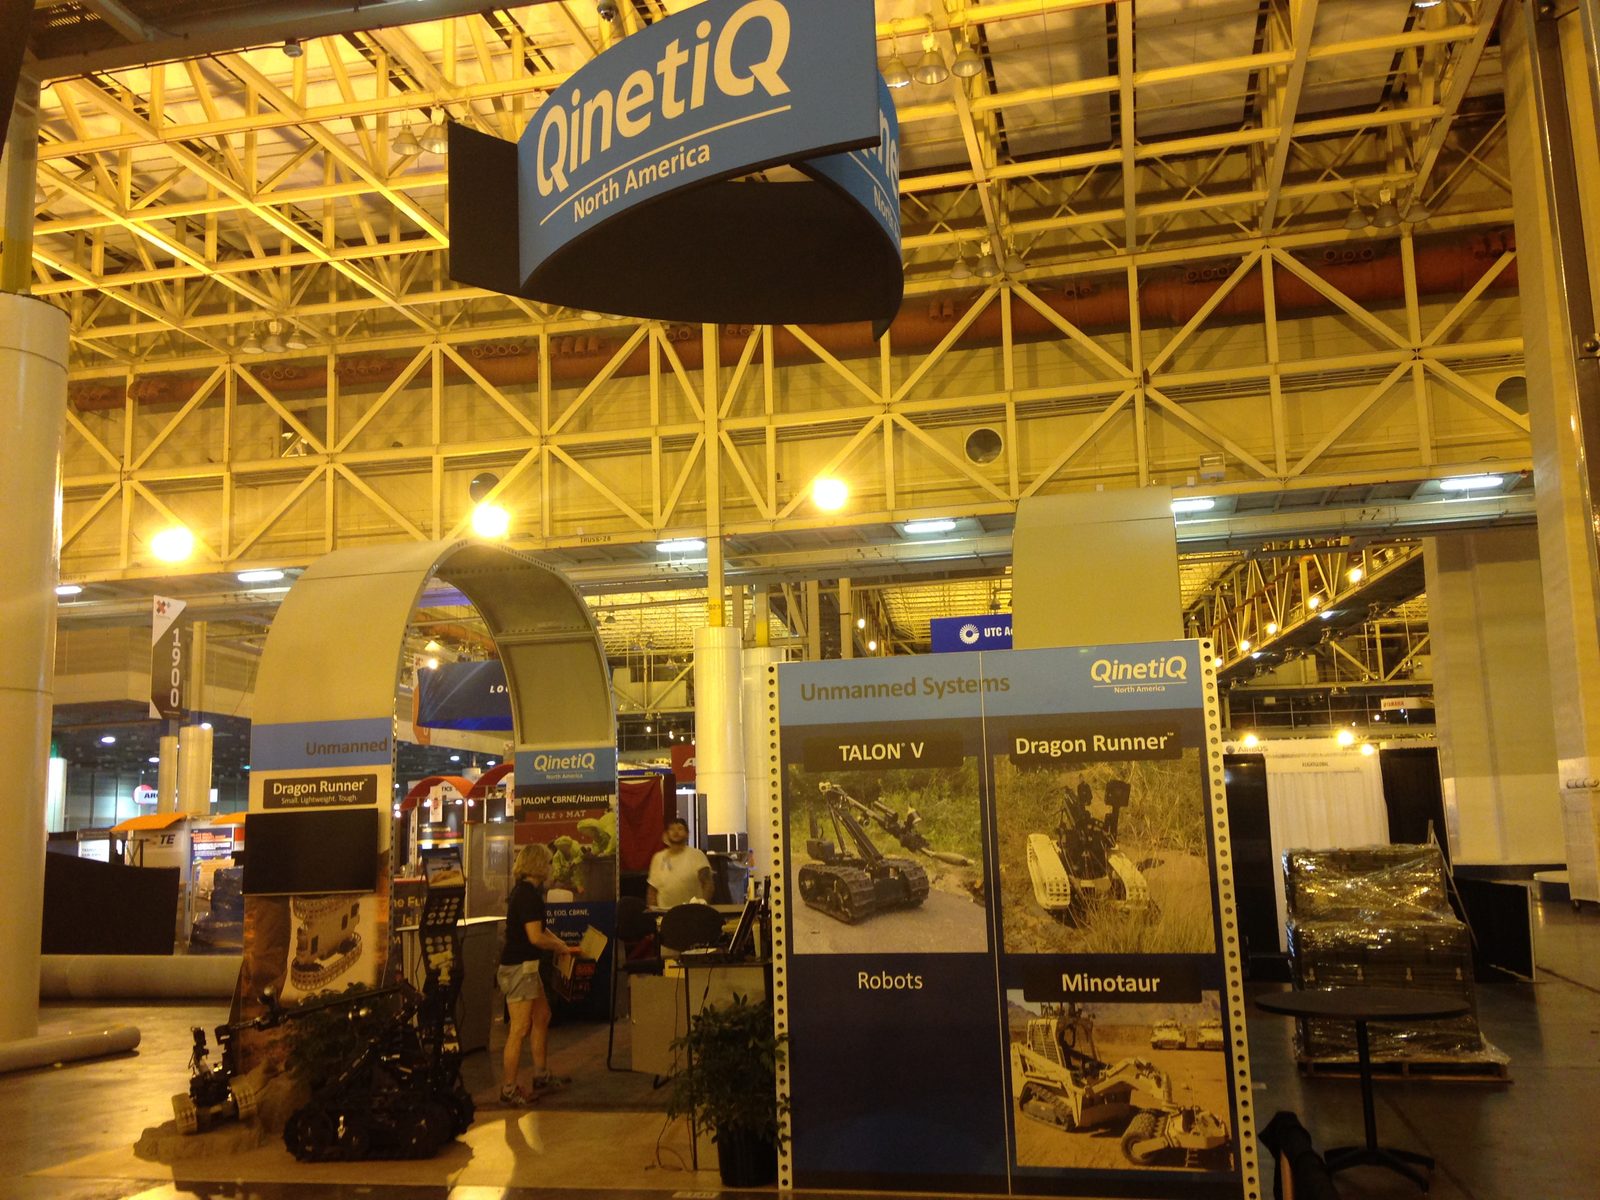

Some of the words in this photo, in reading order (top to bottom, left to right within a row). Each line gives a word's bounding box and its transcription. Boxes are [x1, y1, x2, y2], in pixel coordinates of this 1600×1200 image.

[536, 0, 792, 197] QinetiQ
[573, 173, 620, 224] North
[623, 144, 711, 192] America
[984, 626, 1003, 638] UTC
[169, 627, 181, 708] 1900
[1090, 655, 1187, 683] QinetiQ
[800, 676, 917, 701] Unmanned
[923, 675, 1010, 700] Systems
[1114, 686, 1135, 694] North
[1136, 684, 1166, 693] America
[305, 736, 388, 757] Unmanned
[910, 742, 924, 759] V
[1015, 737, 1087, 757] Dragon
[533, 752, 596, 772] QinetiQ
[273, 782, 317, 797] Dragon
[338, 794, 357, 803] Tough
[551, 793, 609, 805] CBRNE/Hazmat
[159, 834, 176, 845] TE
[858, 971, 924, 990] Robots
[1062, 973, 1160, 993] Minotaur
